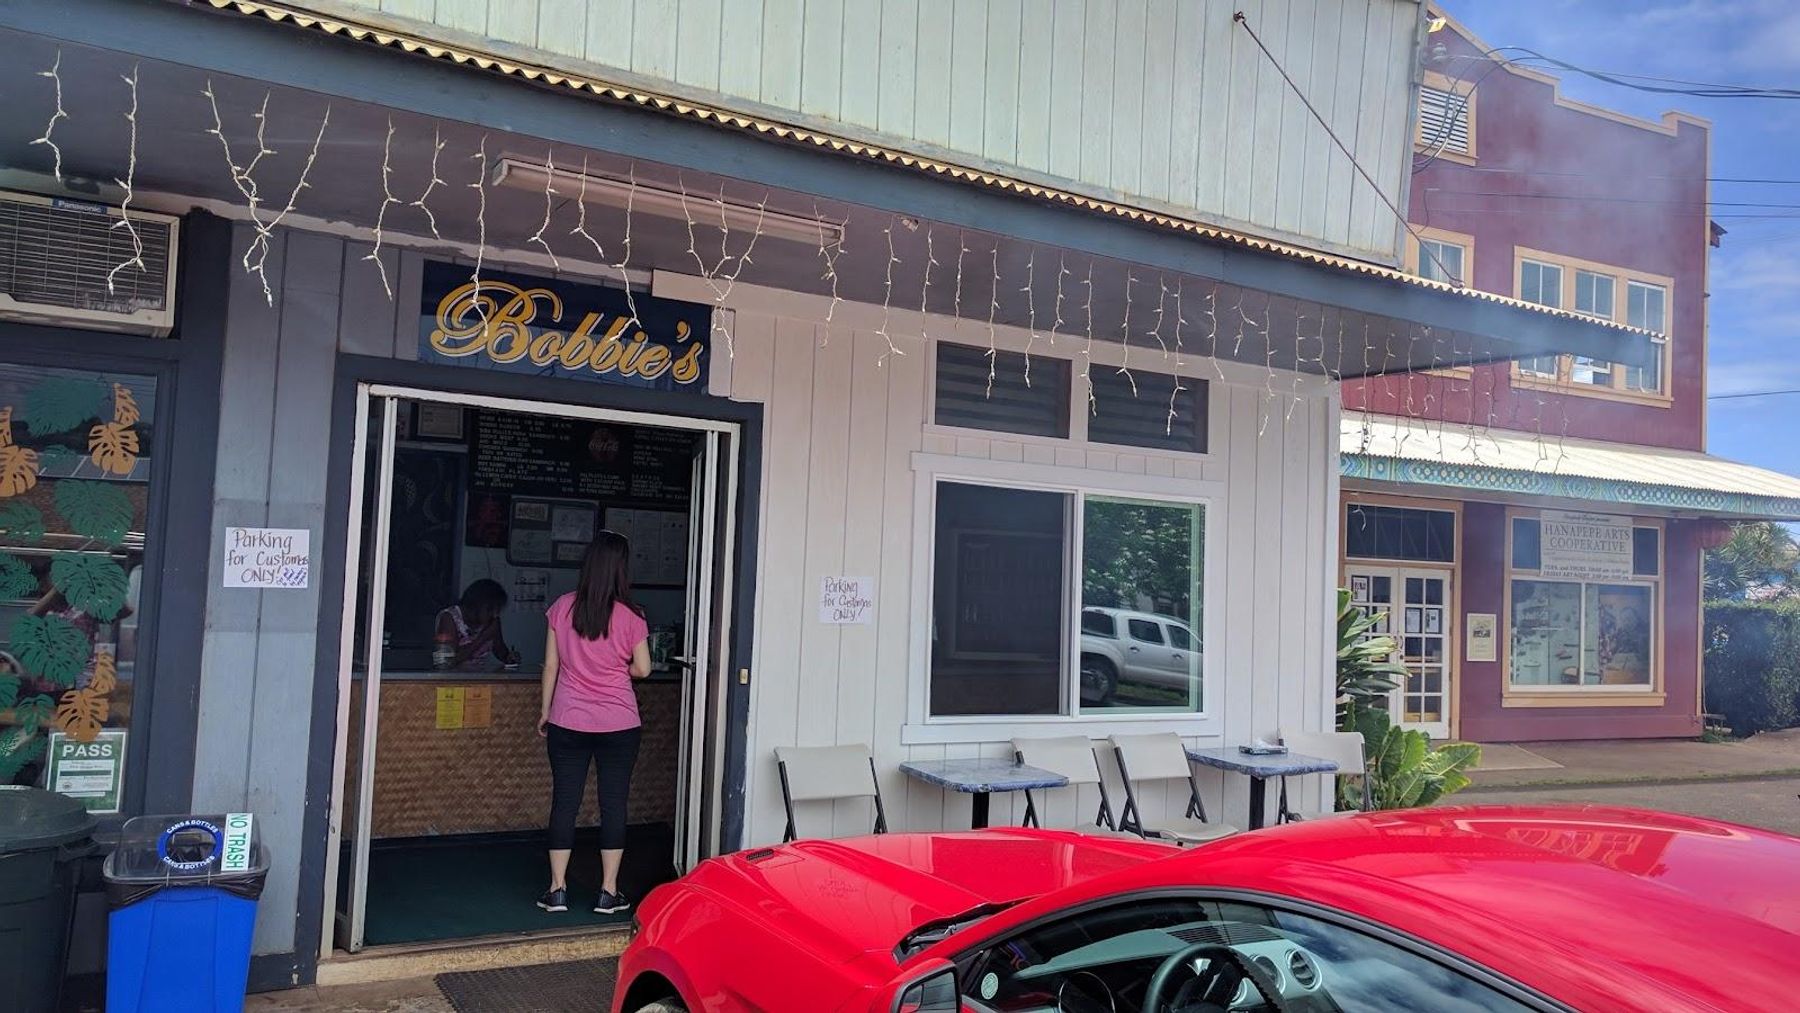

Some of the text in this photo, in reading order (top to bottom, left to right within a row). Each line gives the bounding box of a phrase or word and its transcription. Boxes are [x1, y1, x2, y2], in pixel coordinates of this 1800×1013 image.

[58, 200, 102, 213] Panasonic
[430, 281, 704, 384] Bobbie's
[1545, 523, 1630, 540] HANAPEPE ARTS
[232, 529, 293, 555] Parking
[1550, 537, 1625, 552] COOPERATIVE
[226, 550, 249, 566] for
[824, 576, 858, 598] Parking
[822, 593, 836, 608] for
[62, 744, 113, 757] PASS
[226, 814, 248, 869] NO TRASH
